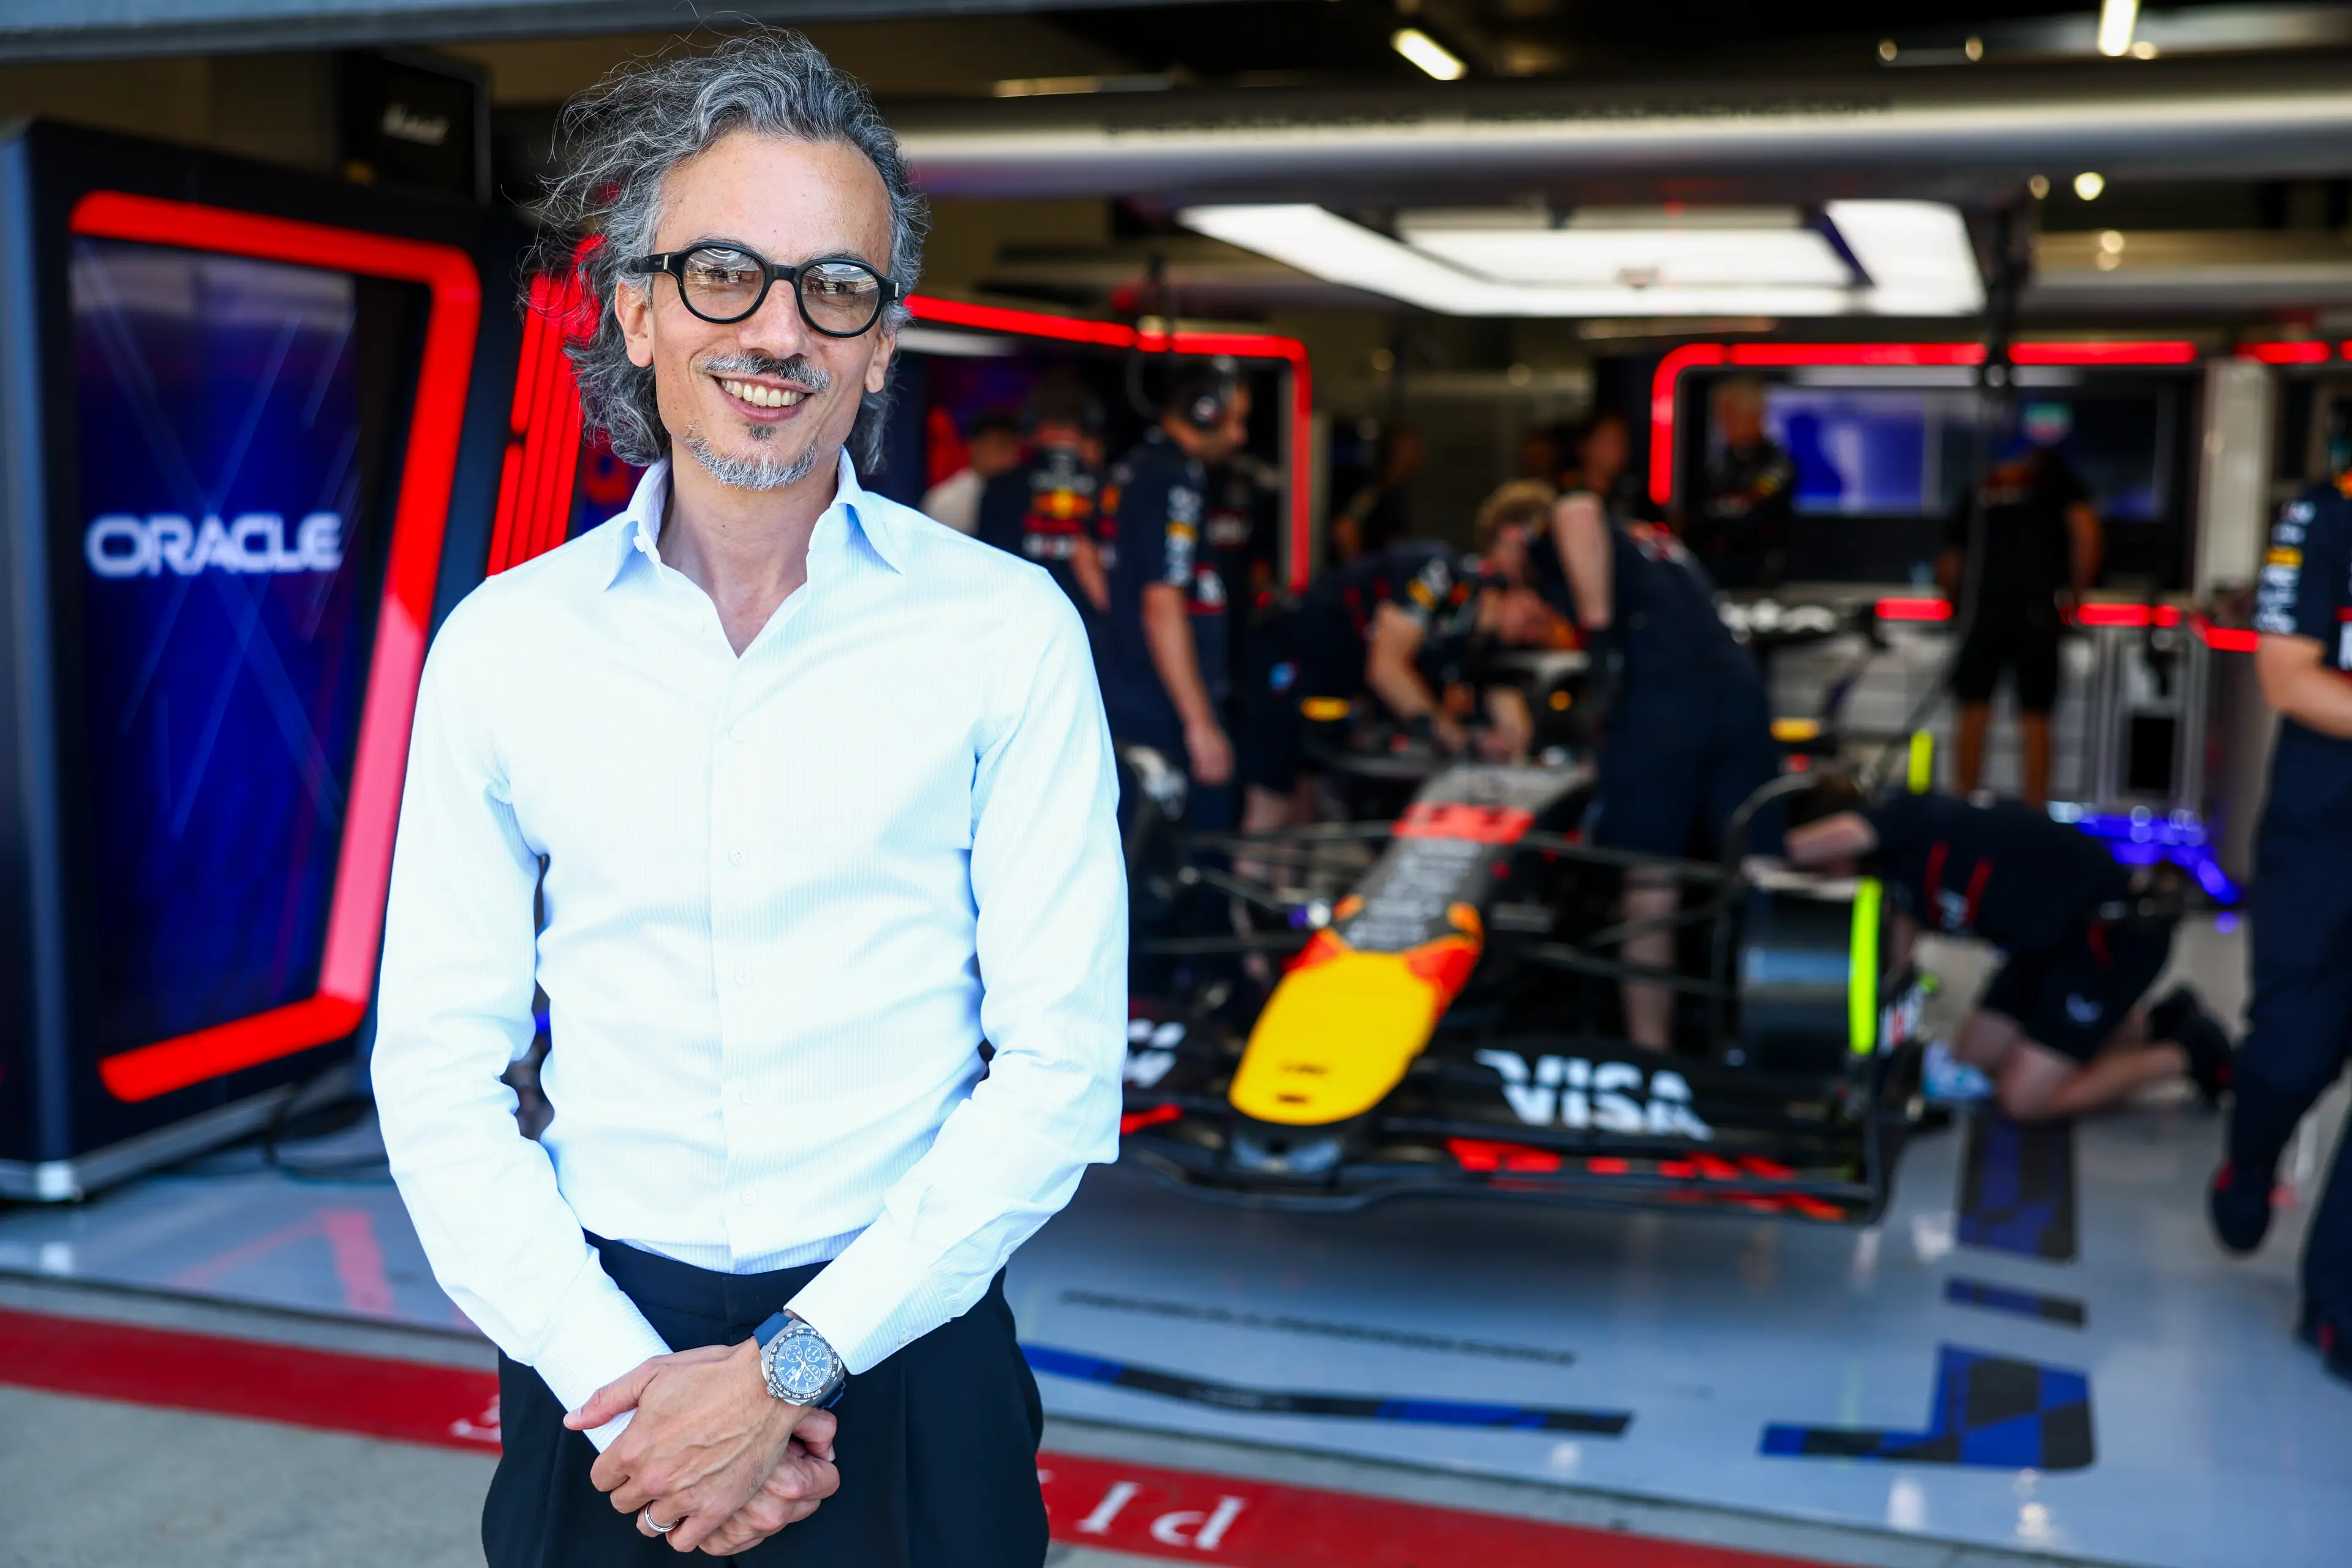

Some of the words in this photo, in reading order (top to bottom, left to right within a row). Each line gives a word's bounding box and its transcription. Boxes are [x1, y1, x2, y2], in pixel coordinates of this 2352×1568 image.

[86, 513, 343, 578] ORACLE
[1474, 1048, 1714, 1142] VISA
[804, 1389, 821, 1398] SPEED
